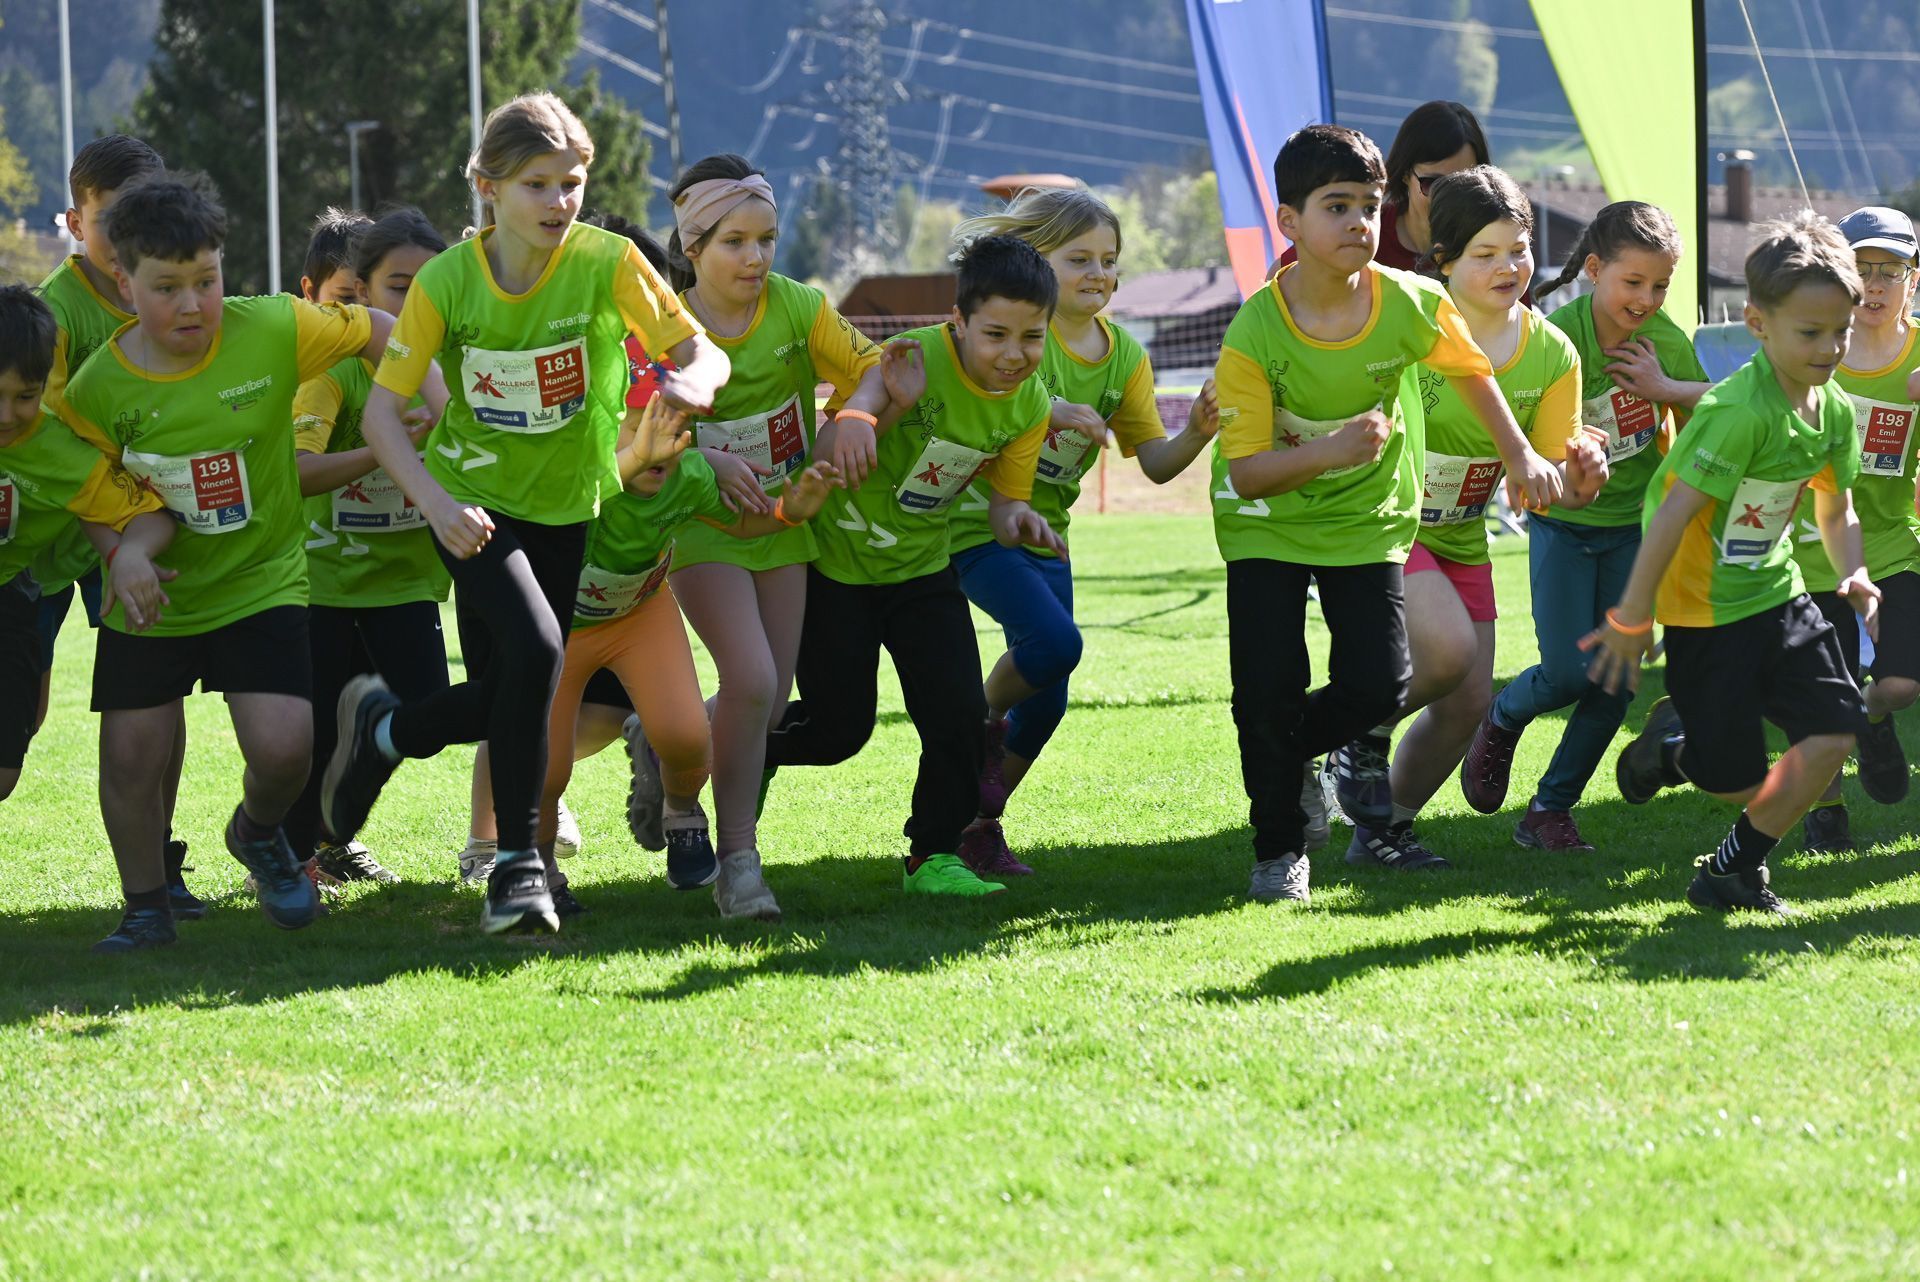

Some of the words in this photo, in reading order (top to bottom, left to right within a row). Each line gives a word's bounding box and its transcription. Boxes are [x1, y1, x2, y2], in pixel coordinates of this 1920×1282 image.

[544, 353, 576, 374] 181
[490, 379, 536, 387] CHALLENGE
[544, 371, 578, 386] Hannah
[218, 374, 272, 399] vorarlberg
[481, 412, 513, 421] SPARKASSE
[773, 410, 793, 433] 200
[1876, 412, 1905, 427] 198
[1878, 429, 1896, 437] Emil
[199, 458, 232, 477] 193
[1470, 466, 1497, 479] 204
[200, 477, 234, 490] Vincent
[360, 484, 400, 494] CHALLENG
